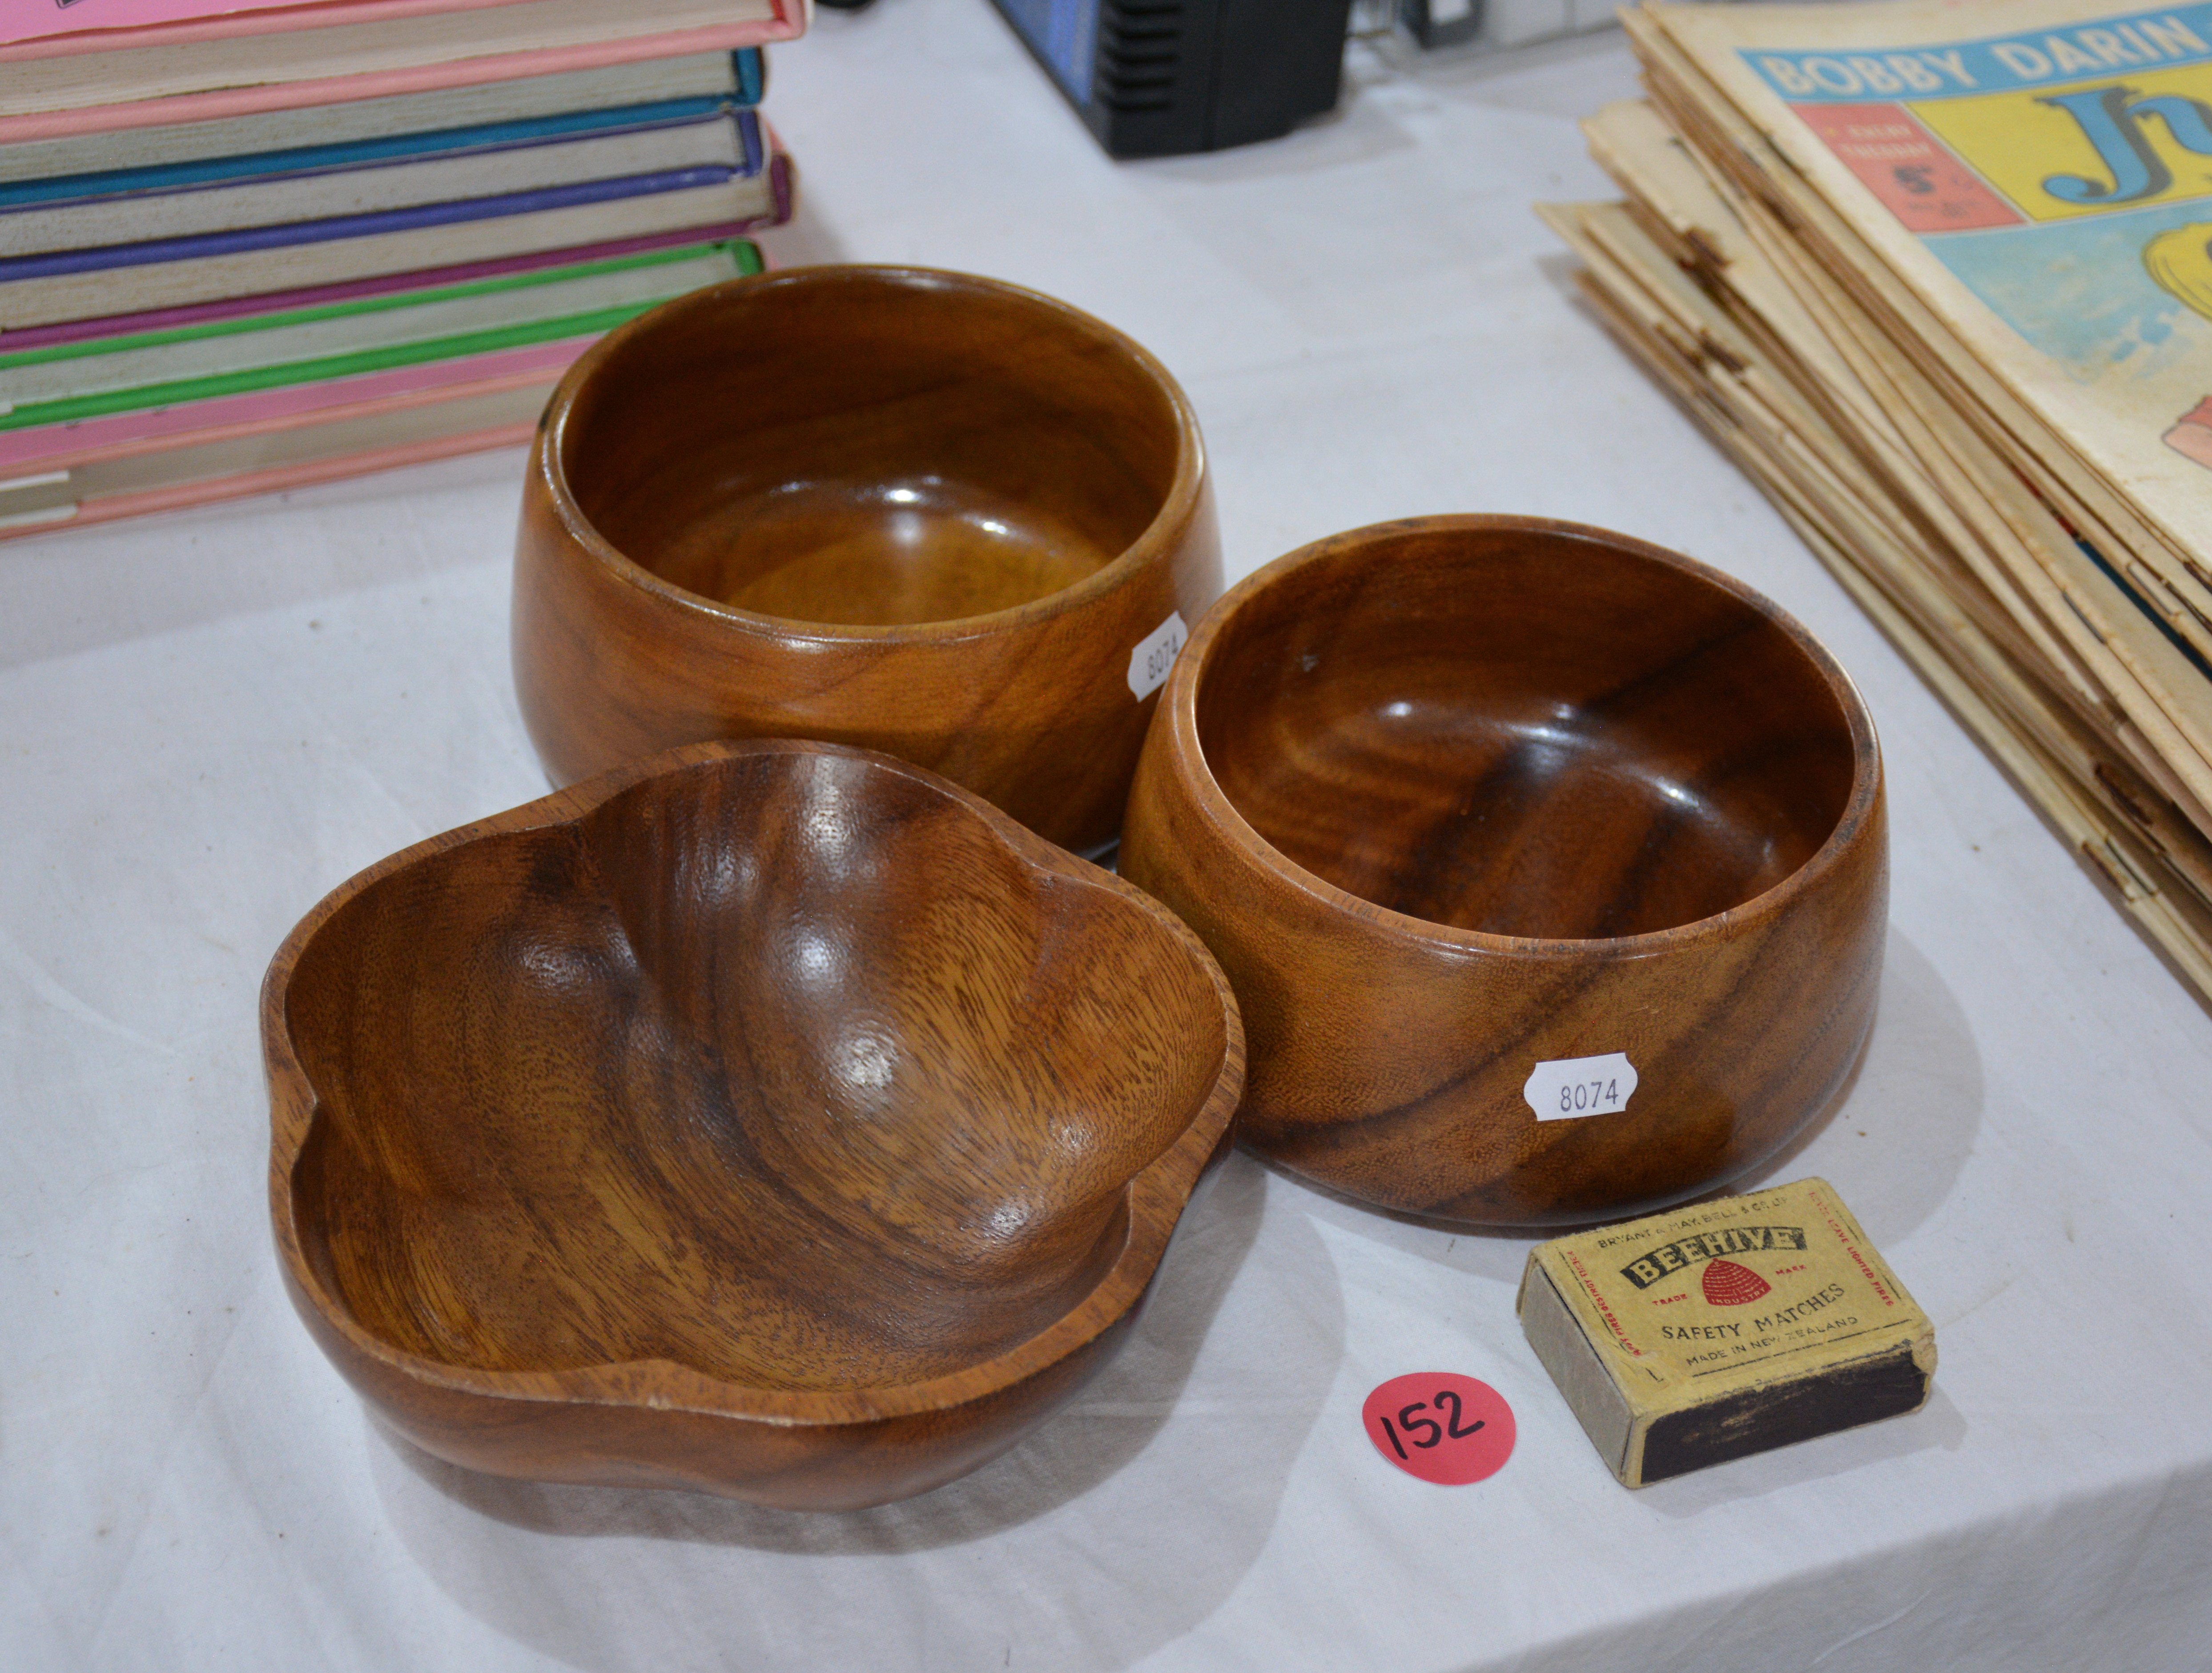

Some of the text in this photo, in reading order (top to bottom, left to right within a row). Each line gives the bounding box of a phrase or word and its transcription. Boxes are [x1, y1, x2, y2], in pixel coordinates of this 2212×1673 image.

[1759, 15, 2210, 95] BOBBY DARIN
[1560, 1079, 1618, 1112] 8074
[1597, 1229, 1651, 1248] BRYANT
[1629, 1227, 1798, 1283] BEEHIVE
[1775, 1264, 1807, 1275] MARK
[1827, 1219, 1849, 1244] LEAVE
[1847, 1247, 1874, 1279] LIGHTED
[1870, 1282, 1894, 1307] FIRES
[1584, 1279, 1609, 1311] DESTROY
[1652, 1294, 1688, 1306] TRADE
[1661, 1283, 1846, 1340] SAFETY MATCHES
[1711, 1287, 1766, 1305] INDUSTRY
[1605, 1313, 1624, 1336] FIRES
[1686, 1316, 1859, 1366] MADE IN NEW ZEALAND
[1380, 1391, 1485, 1460] 152
